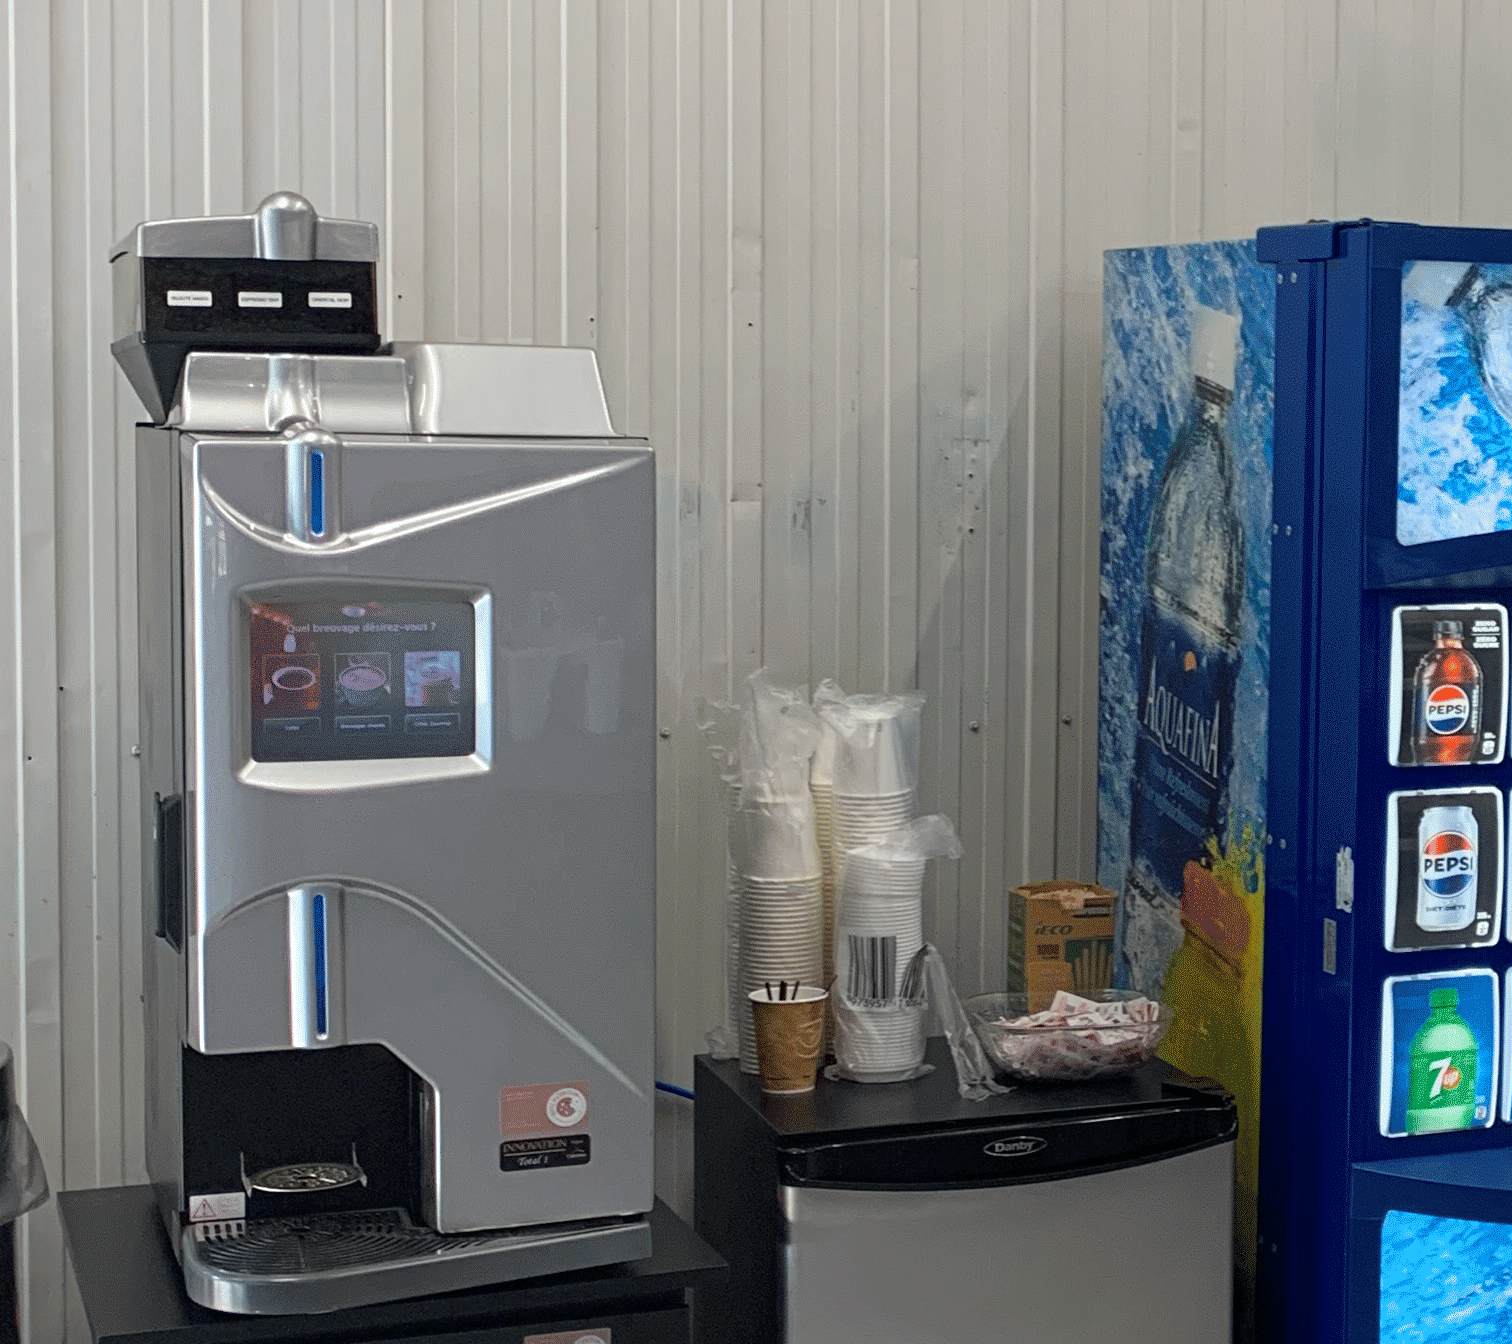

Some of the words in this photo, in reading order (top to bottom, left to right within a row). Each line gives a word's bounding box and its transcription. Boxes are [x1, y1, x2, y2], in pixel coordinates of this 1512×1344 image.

[1428, 704, 1466, 716] PEPSI
[1143, 657, 1219, 778] AQUAFINA
[1424, 857, 1473, 873] PEPSI
[994, 1141, 1038, 1153] Danby
